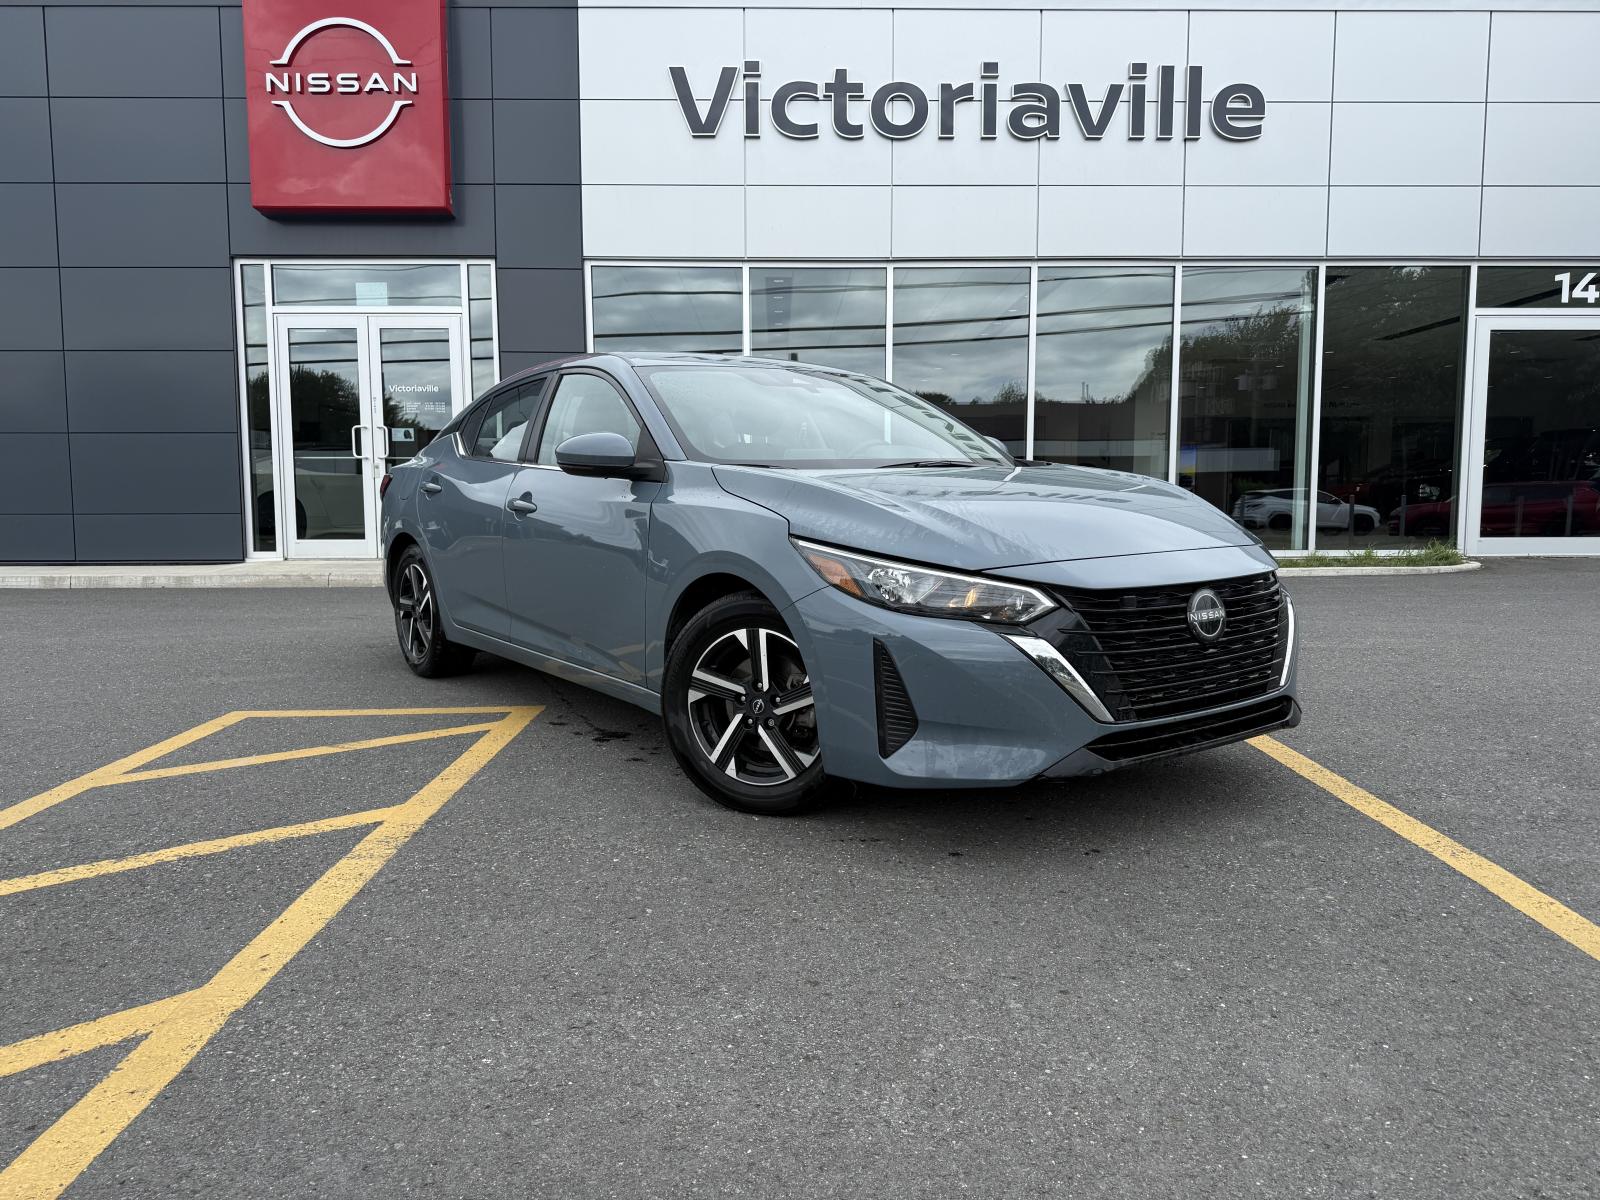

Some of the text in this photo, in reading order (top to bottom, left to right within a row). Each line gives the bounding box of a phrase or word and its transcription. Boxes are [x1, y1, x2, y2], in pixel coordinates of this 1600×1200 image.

[265, 72, 417, 93] NISSAN
[669, 60, 1267, 141] Victoriaville
[1554, 272, 1600, 304] 14
[389, 384, 439, 393] Victoriaville
[1190, 610, 1225, 621] NISSAN
